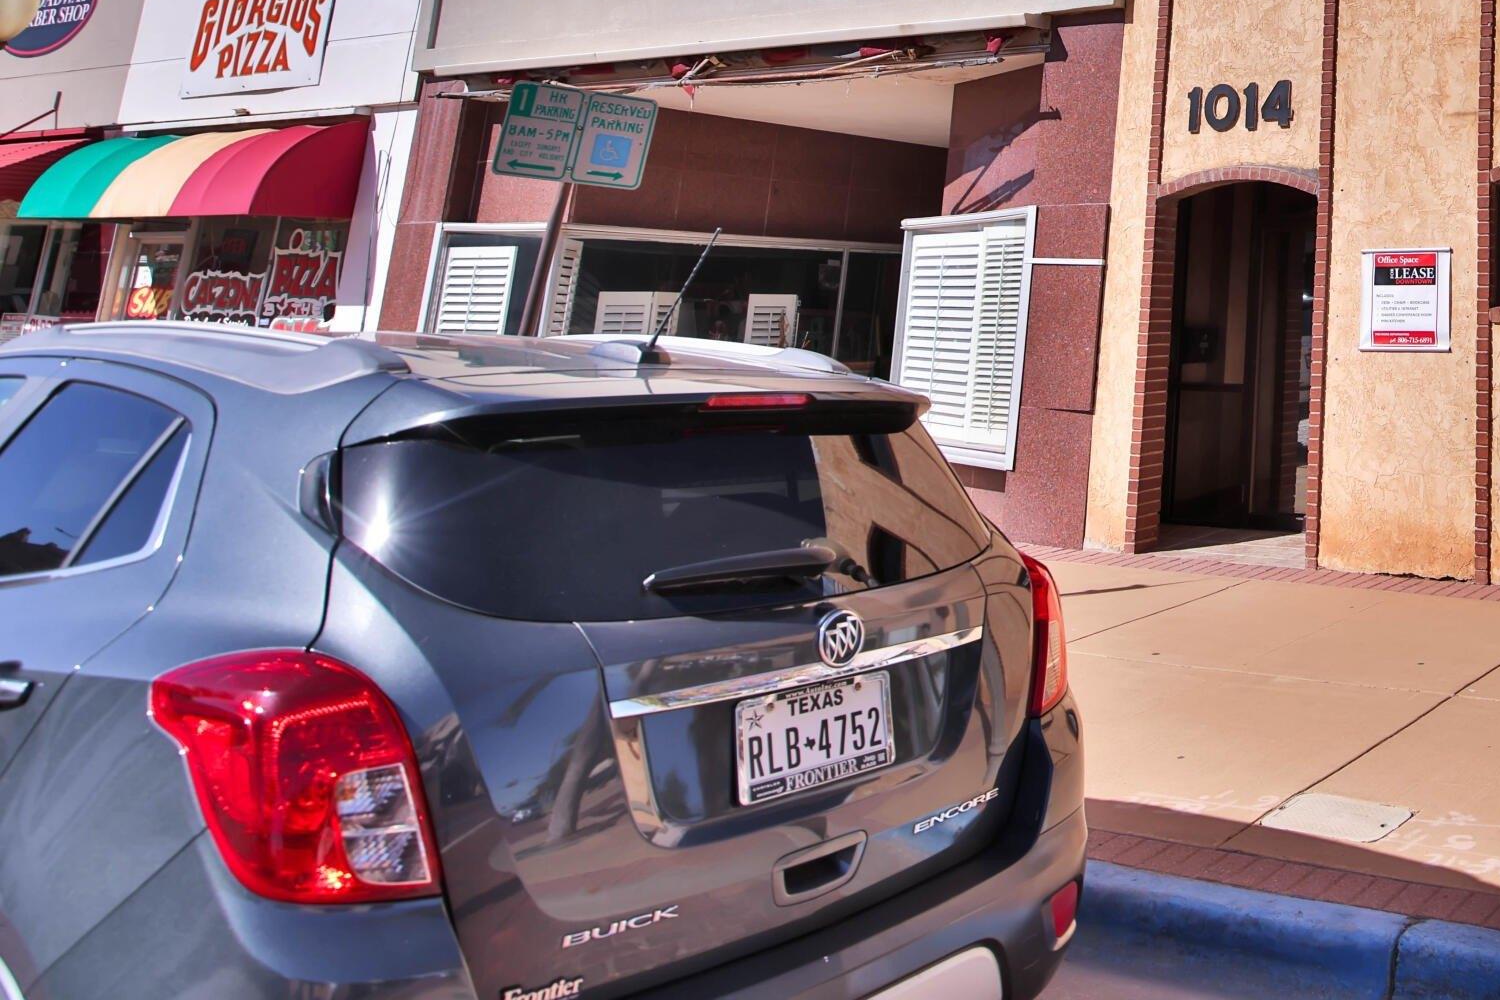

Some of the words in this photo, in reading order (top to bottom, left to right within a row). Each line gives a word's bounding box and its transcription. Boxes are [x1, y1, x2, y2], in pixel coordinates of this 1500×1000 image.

[57, 3, 90, 23] SHOP
[215, 29, 291, 79] PIZZA
[549, 91, 569, 104] HR
[1188, 80, 1294, 134] 1014
[534, 104, 576, 120] PARKING
[591, 100, 651, 119] RESERVED
[591, 117, 644, 134] PARKING
[1377, 256, 1398, 264] Office
[1399, 256, 1419, 265] Space
[1395, 267, 1435, 279] LEASE
[787, 689, 844, 716] TEXAS
[785, 758, 860, 792] FRONTIER
[913, 787, 999, 834] ENCORE
[562, 905, 679, 948] BUICK
[502, 977, 583, 1000] Frontier
